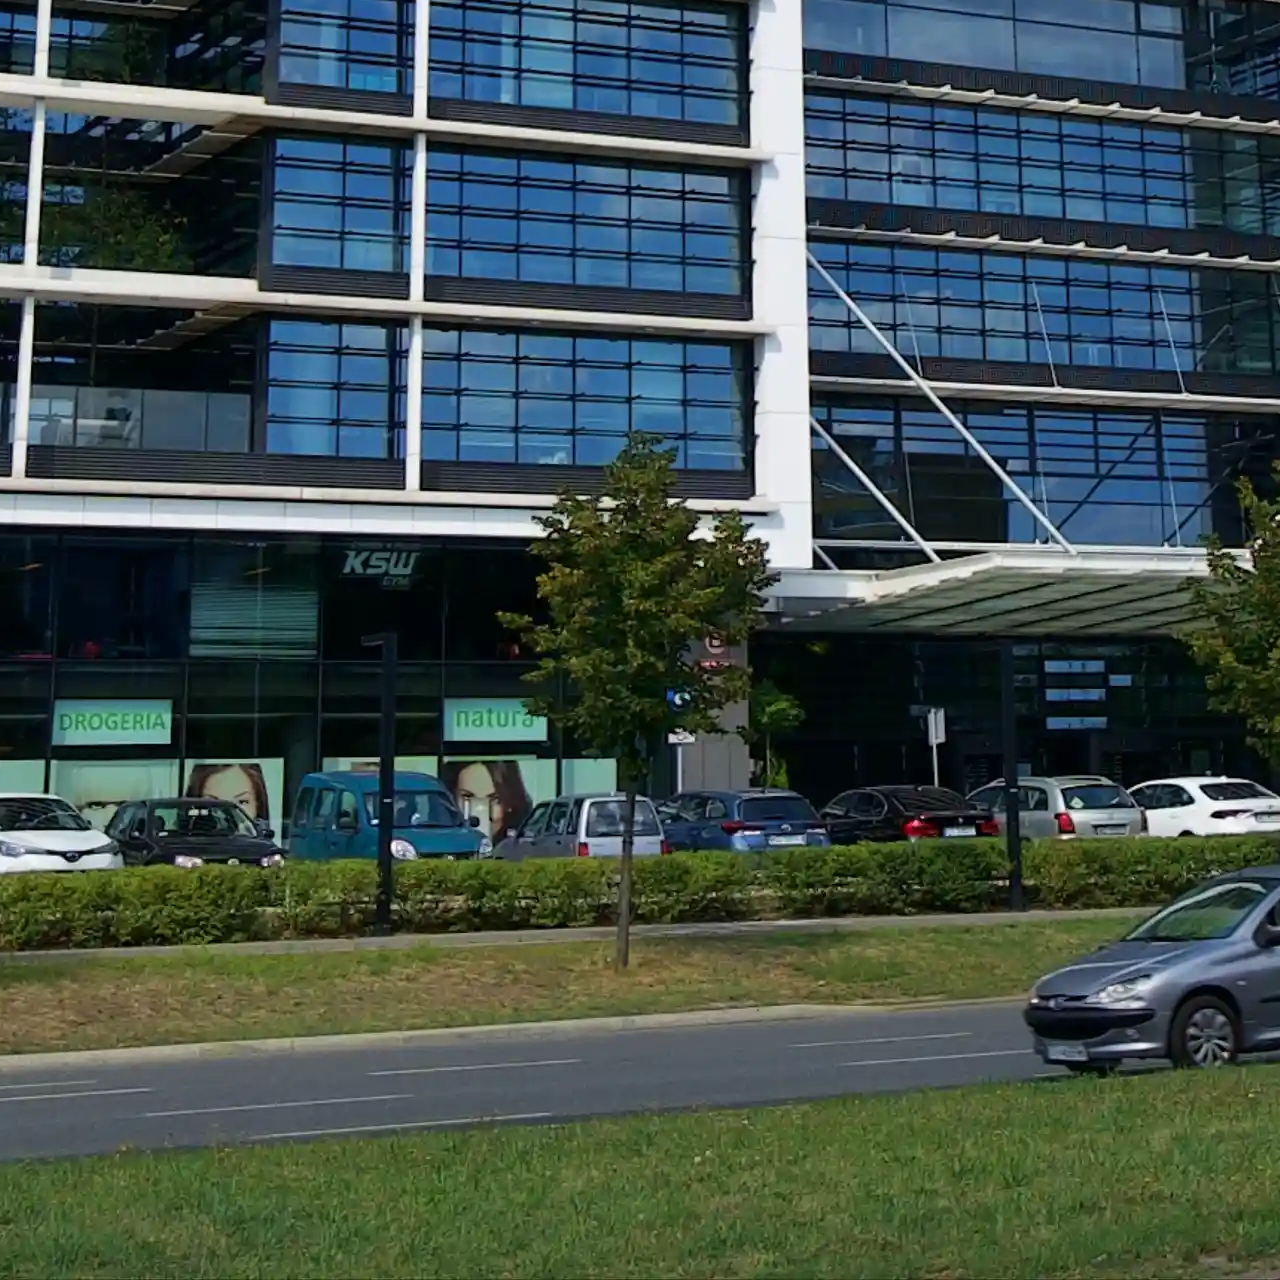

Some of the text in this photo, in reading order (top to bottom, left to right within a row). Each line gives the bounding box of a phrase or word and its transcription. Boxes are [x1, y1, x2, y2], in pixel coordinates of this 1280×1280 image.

[342, 549, 421, 575] KSW
[59, 711, 166, 732] DROGERIA
[455, 707, 535, 729] natura
